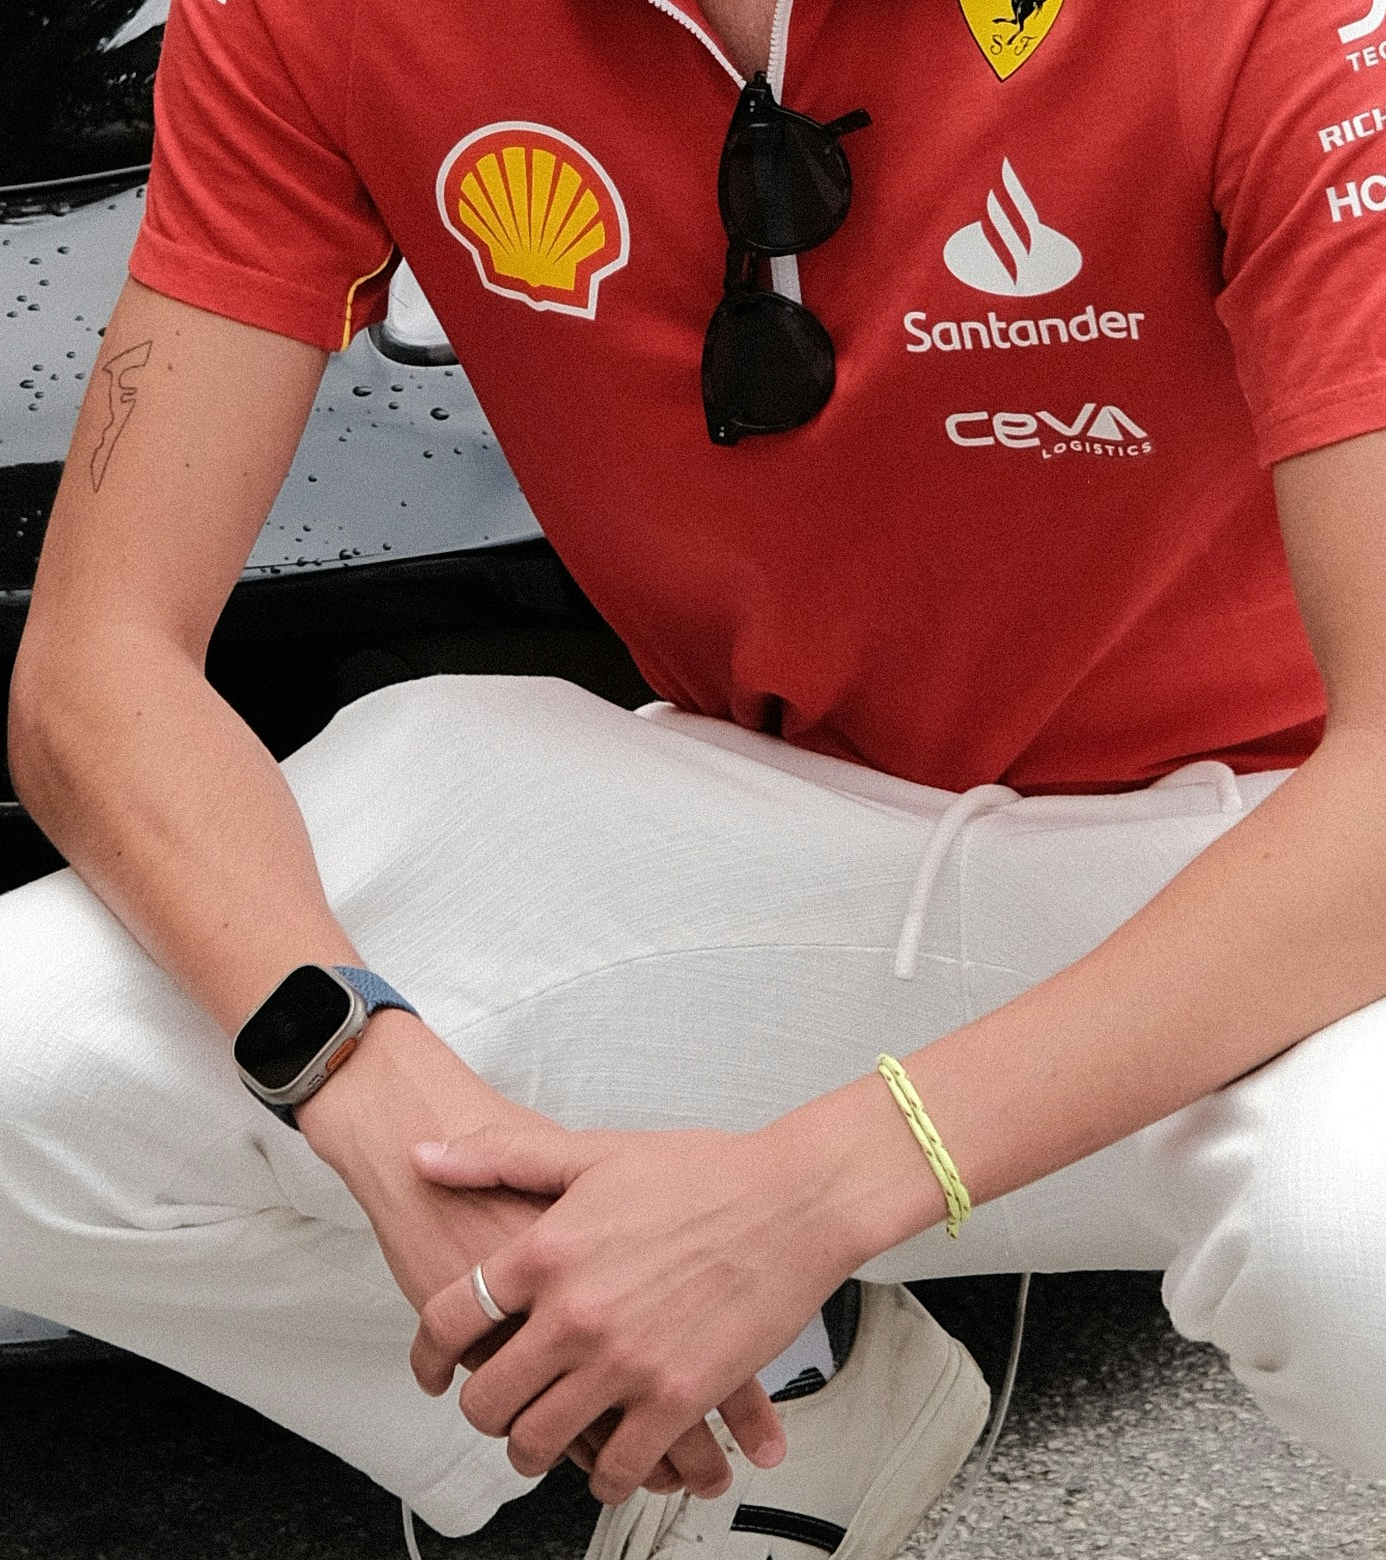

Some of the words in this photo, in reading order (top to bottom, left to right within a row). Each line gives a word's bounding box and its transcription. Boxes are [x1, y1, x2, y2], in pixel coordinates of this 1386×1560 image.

[989, 33, 1004, 56] S
[902, 304, 1146, 355] Santander
[1041, 440, 1153, 460] LOGISTICS
